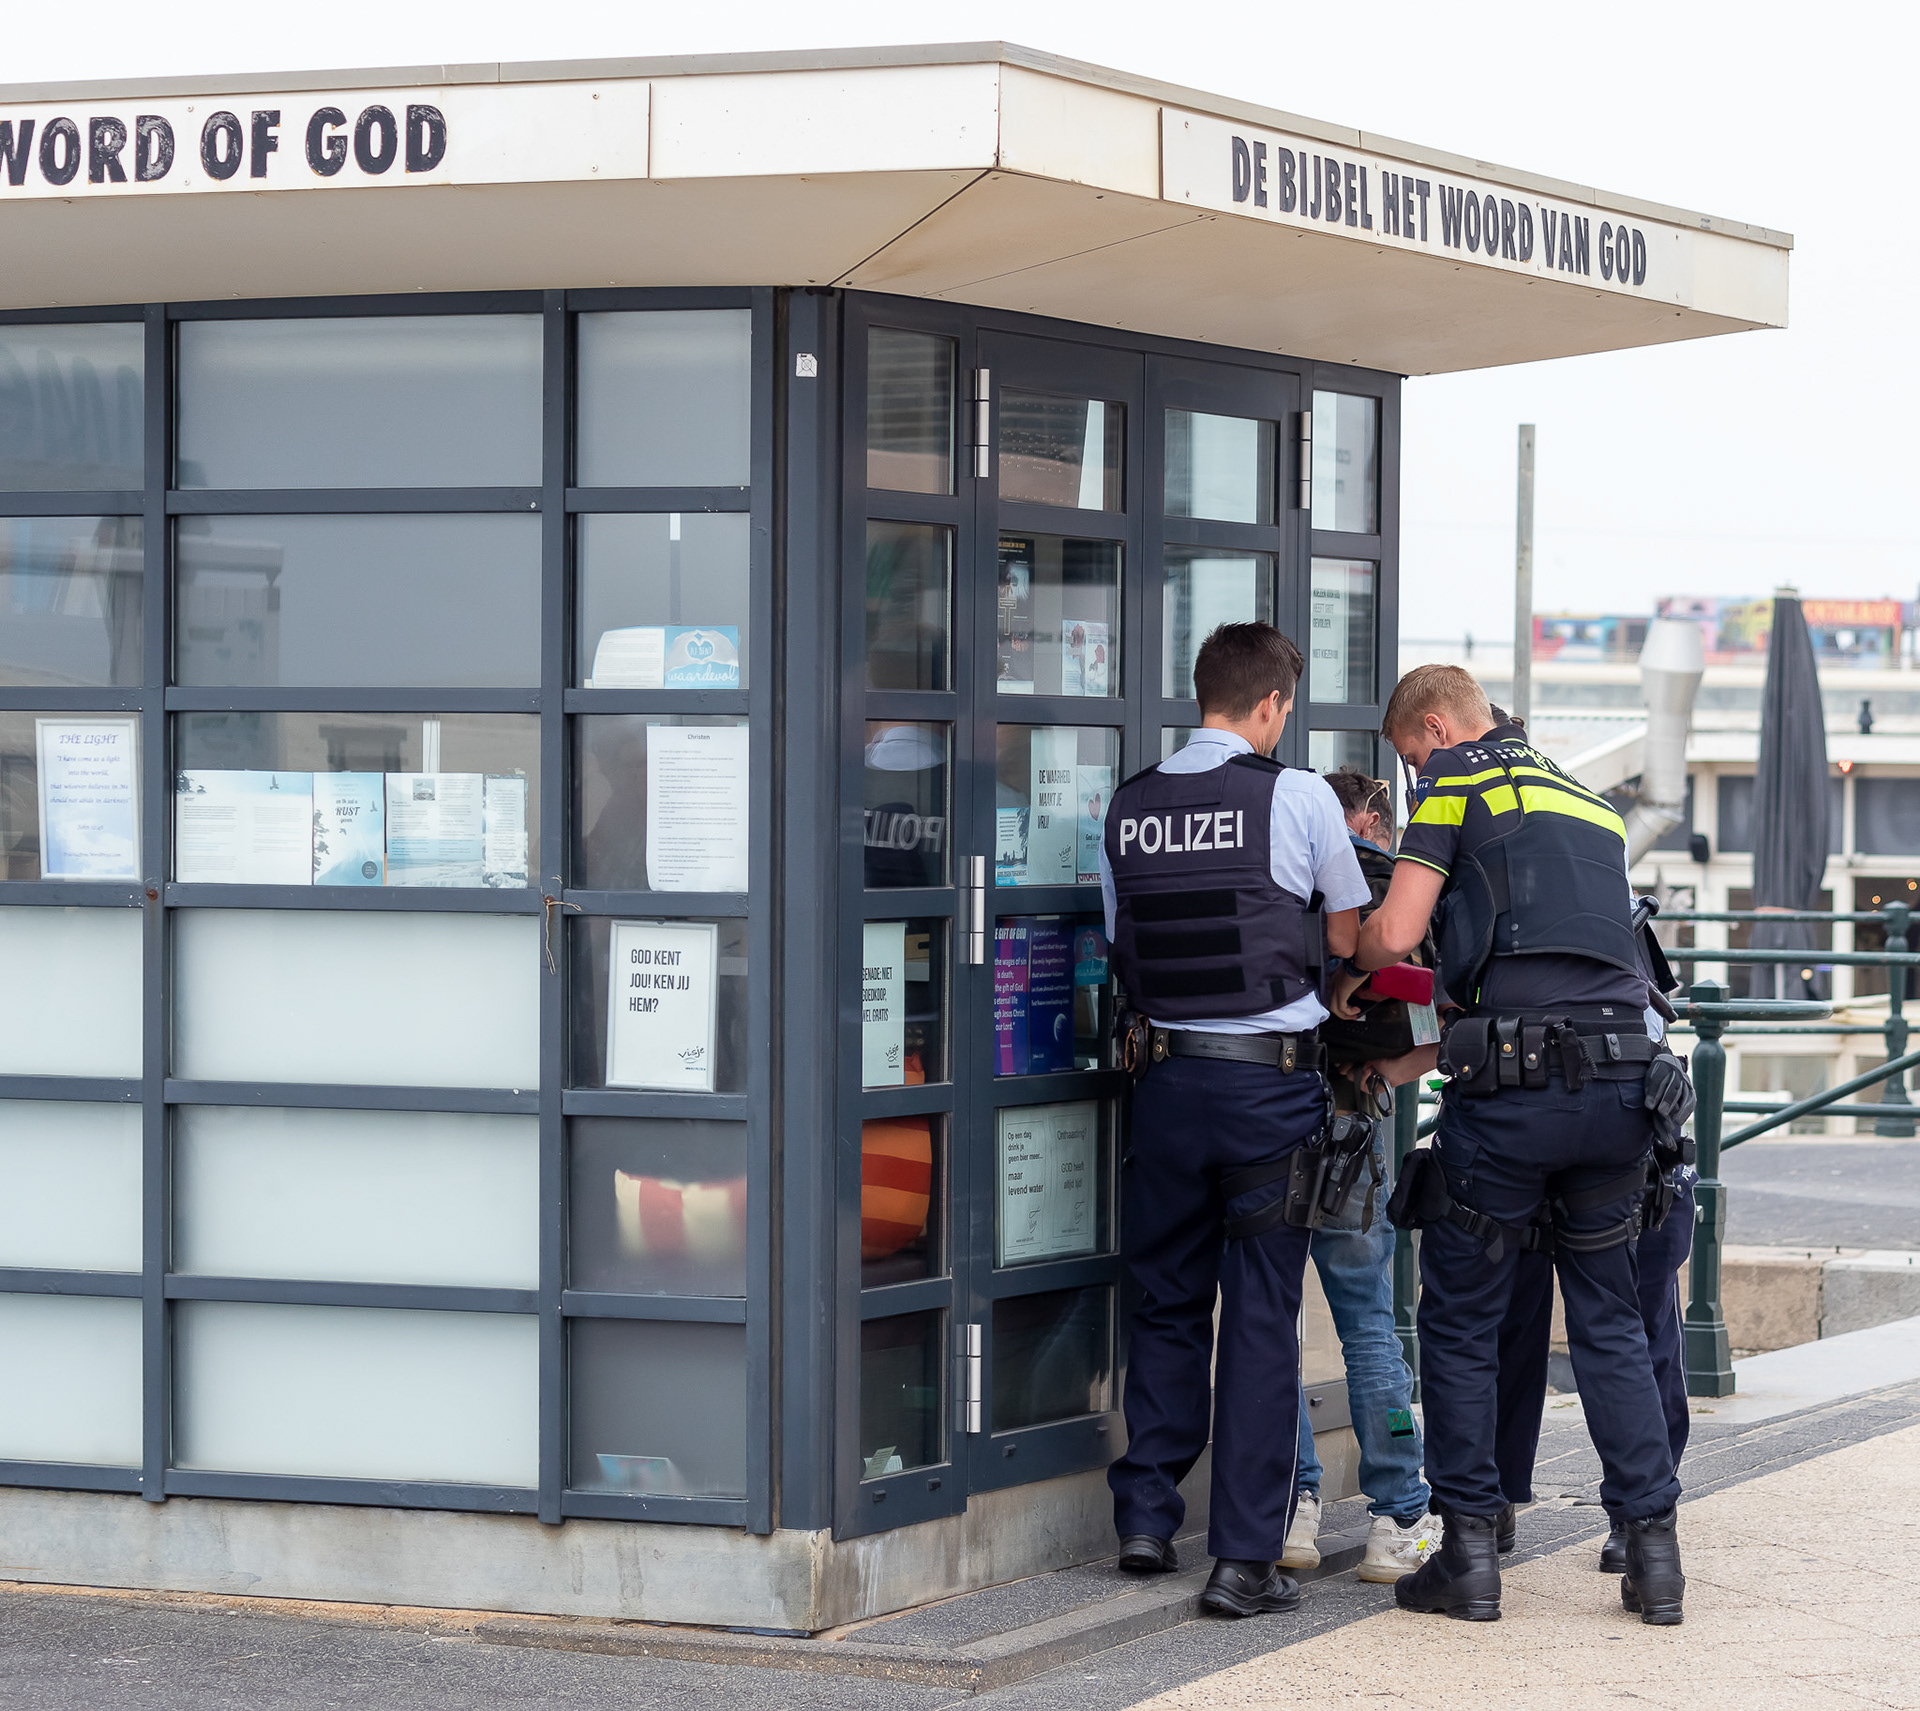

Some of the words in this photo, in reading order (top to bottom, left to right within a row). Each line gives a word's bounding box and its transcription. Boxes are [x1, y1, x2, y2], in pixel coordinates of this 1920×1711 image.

[0, 115, 176, 186] WORD
[200, 110, 281, 181] OF
[306, 104, 447, 177] GOD
[1231, 136, 1268, 208] DE
[1278, 147, 1373, 230] BIJBEL
[1382, 171, 1430, 242] HET
[1439, 184, 1534, 263] WOORD
[1541, 208, 1590, 276] VAN
[1599, 221, 1647, 286] GOD
[668, 664, 738, 681] waardevol
[60, 734, 81, 744] THE
[84, 734, 119, 746] LIGHT
[1039, 770, 1046, 784] DE
[1039, 793, 1056, 806] MAAKT
[335, 807, 360, 816] RUST
[1120, 810, 1244, 856] POLIZEI
[1010, 927, 1016, 940] OF
[1016, 927, 1027, 940] GOD
[631, 949, 651, 964] GOD
[654, 950, 681, 966] KENT
[1003, 959, 1015, 967] wages
[1015, 957, 1020, 965] of
[882, 967, 893, 980] NIET
[630, 973, 651, 988] JOU!
[654, 974, 675, 990] KEN
[677, 976, 689, 990] JIJ
[1010, 983, 1014, 991] of
[1015, 983, 1023, 991] God
[630, 997, 659, 1013] HEM?
[873, 1009, 889, 1022] GRATIS
[1013, 1009, 1025, 1017] Christ
[1008, 1132, 1014, 1141] Op
[1023, 1131, 1031, 1140] dag
[1008, 1143, 1019, 1151] drink
[1020, 1143, 1024, 1152] je
[1008, 1156, 1019, 1164] geen
[1020, 1153, 1028, 1161] bier
[1061, 1162, 1072, 1173] GOD
[1008, 1185, 1027, 1195] levend
[1029, 1184, 1043, 1193] water
